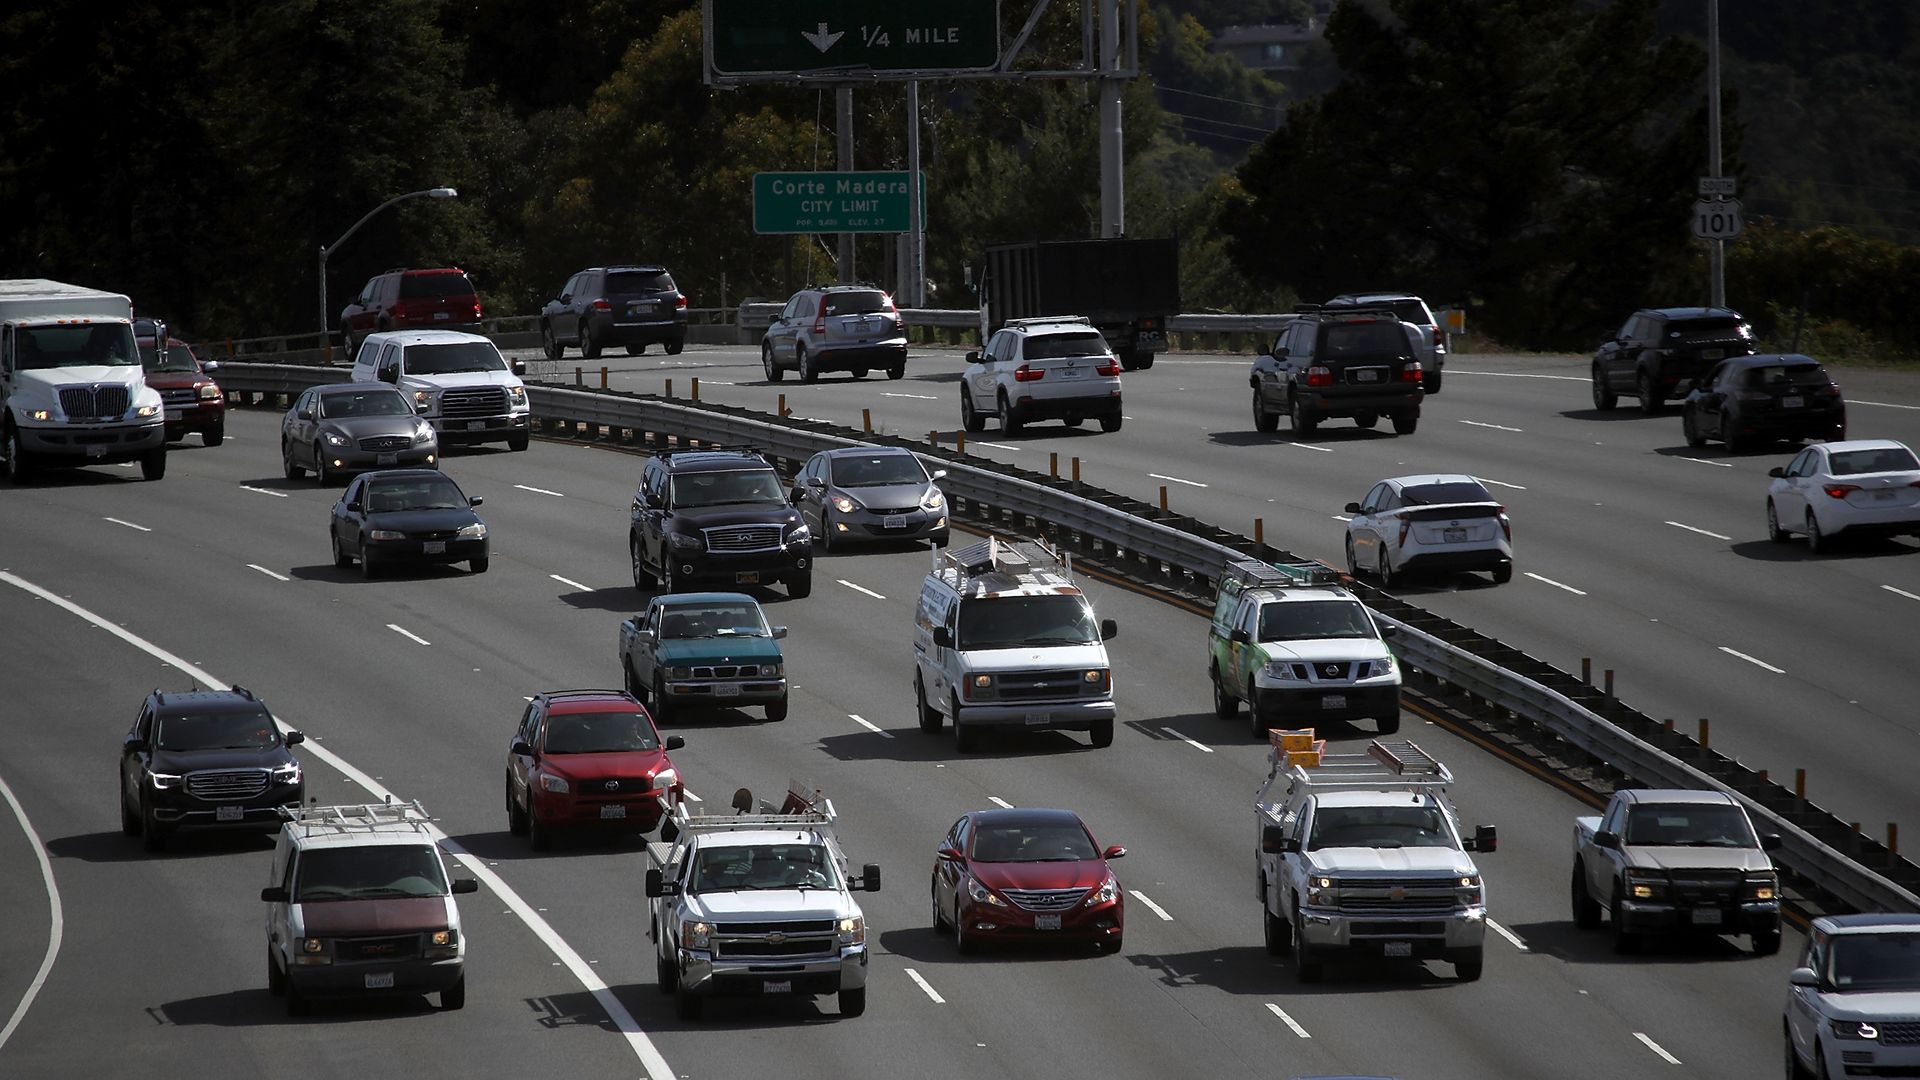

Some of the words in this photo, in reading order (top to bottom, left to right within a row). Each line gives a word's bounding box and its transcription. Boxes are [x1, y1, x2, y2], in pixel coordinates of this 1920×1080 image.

[905, 27, 959, 43] MILE
[772, 179, 825, 195] Corte
[836, 180, 908, 194] Madera
[801, 200, 833, 212] CITY
[842, 200, 879, 212] LIMIT
[1700, 214, 1734, 233] 101
